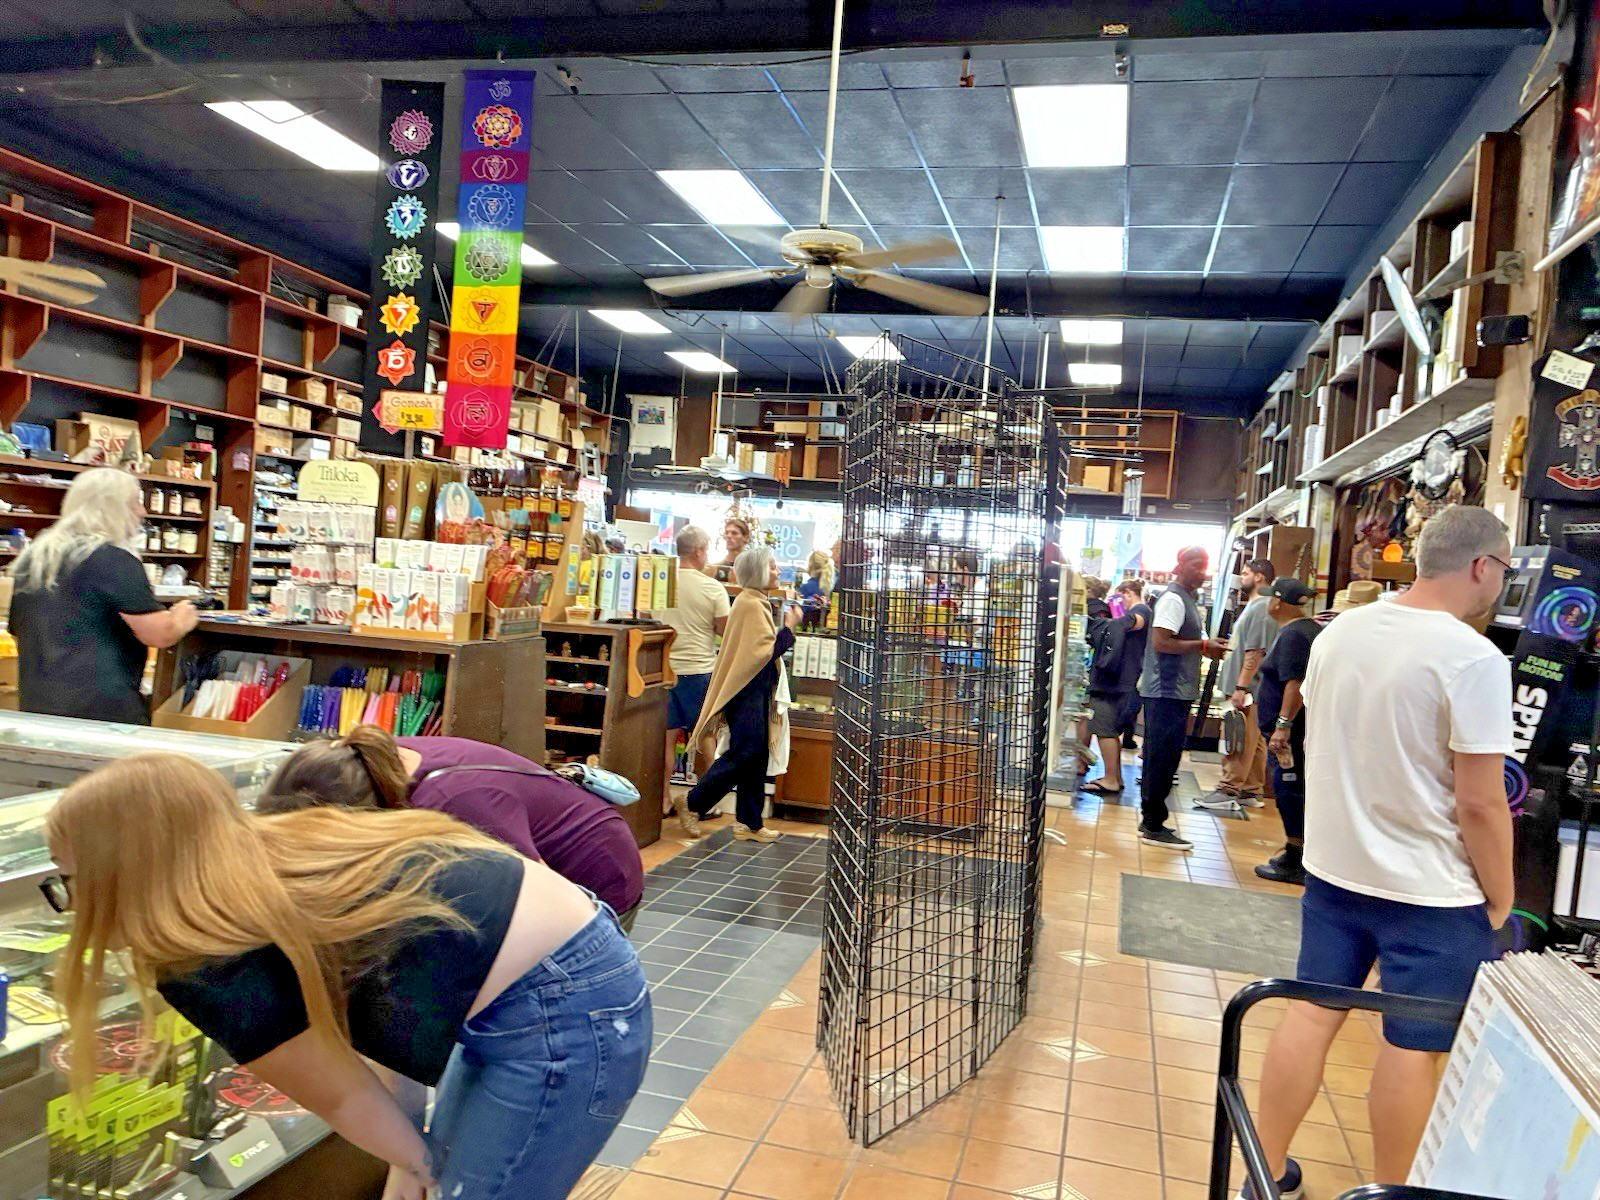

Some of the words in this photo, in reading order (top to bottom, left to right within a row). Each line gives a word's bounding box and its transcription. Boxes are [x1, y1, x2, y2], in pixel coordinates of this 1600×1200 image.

[390, 396, 433, 408] Ganesh
[318, 464, 360, 483] Triloka
[1527, 655, 1549, 668] FUN
[141, 1101, 175, 1124] TRUE
[241, 1140, 271, 1160] TRUE
